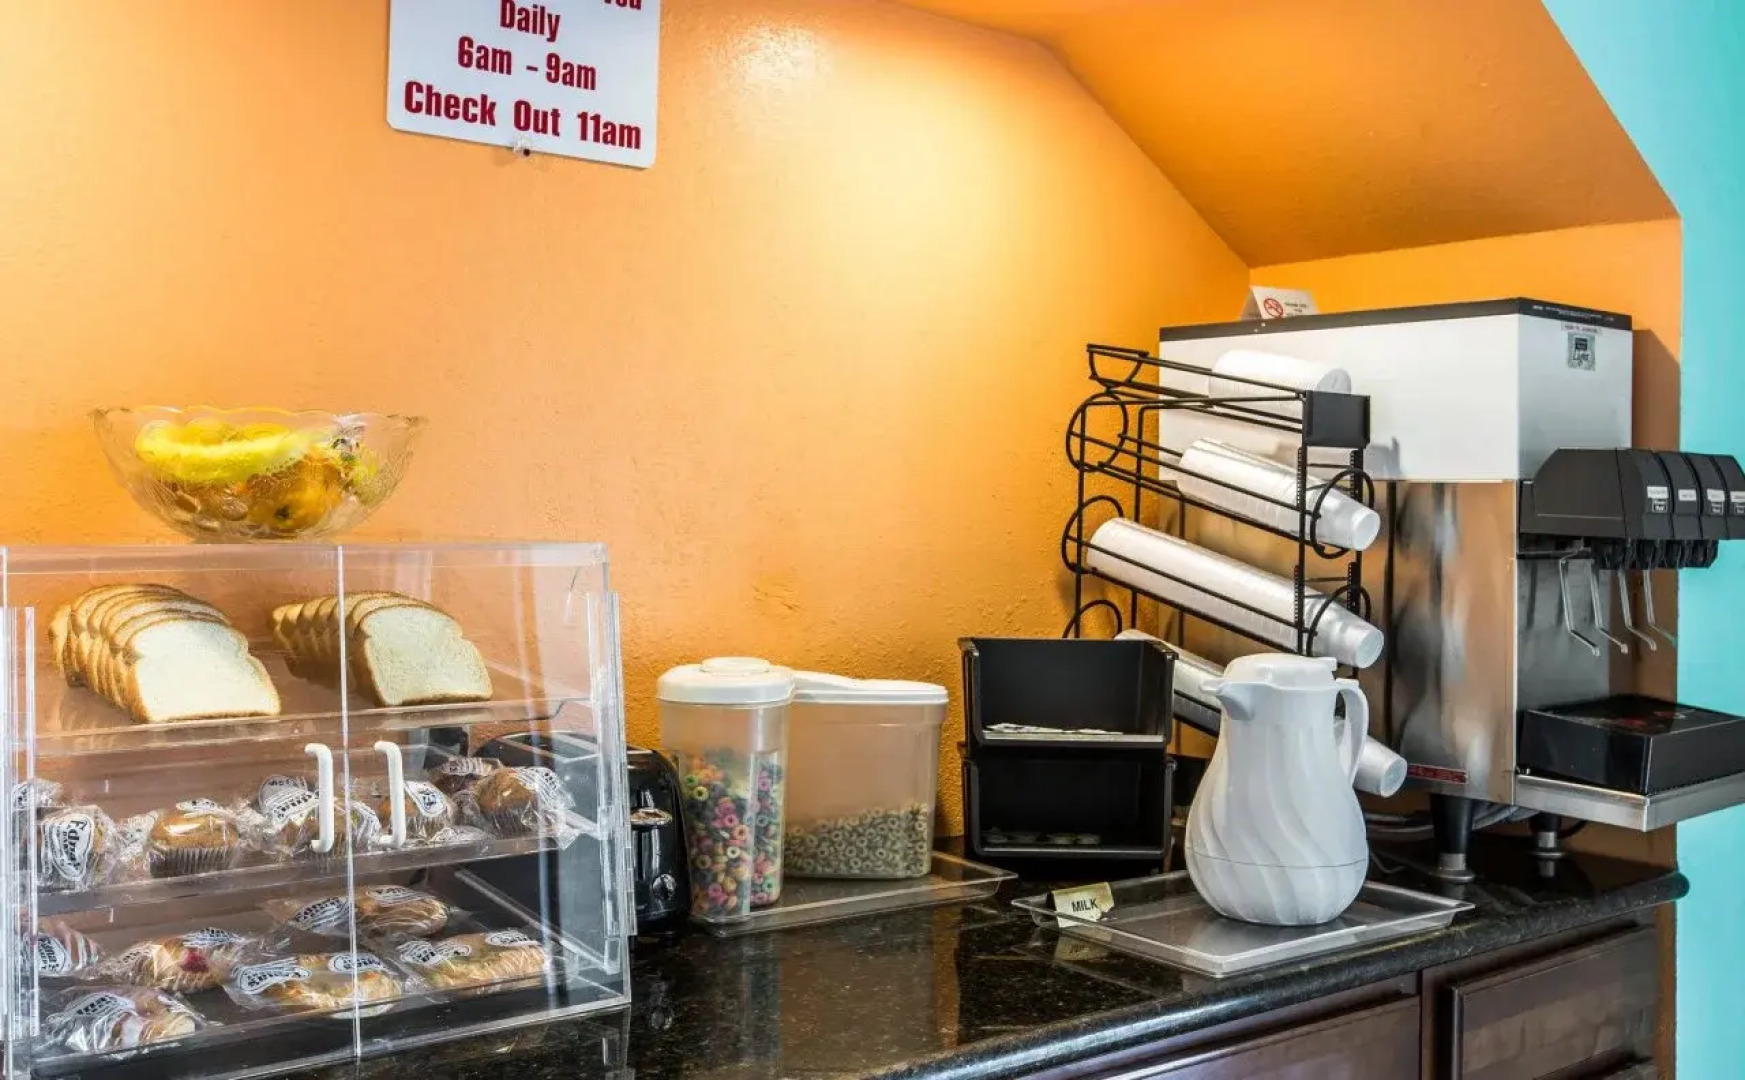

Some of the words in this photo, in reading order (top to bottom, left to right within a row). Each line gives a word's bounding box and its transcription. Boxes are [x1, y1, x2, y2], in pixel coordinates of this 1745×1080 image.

[499, 0, 561, 42] Daily
[457, 36, 512, 75] 6am
[545, 52, 597, 91] 9am
[404, 81, 497, 126] Check
[513, 100, 561, 137] Out
[577, 111, 641, 150] 11am
[1071, 898, 1099, 913] MILK
